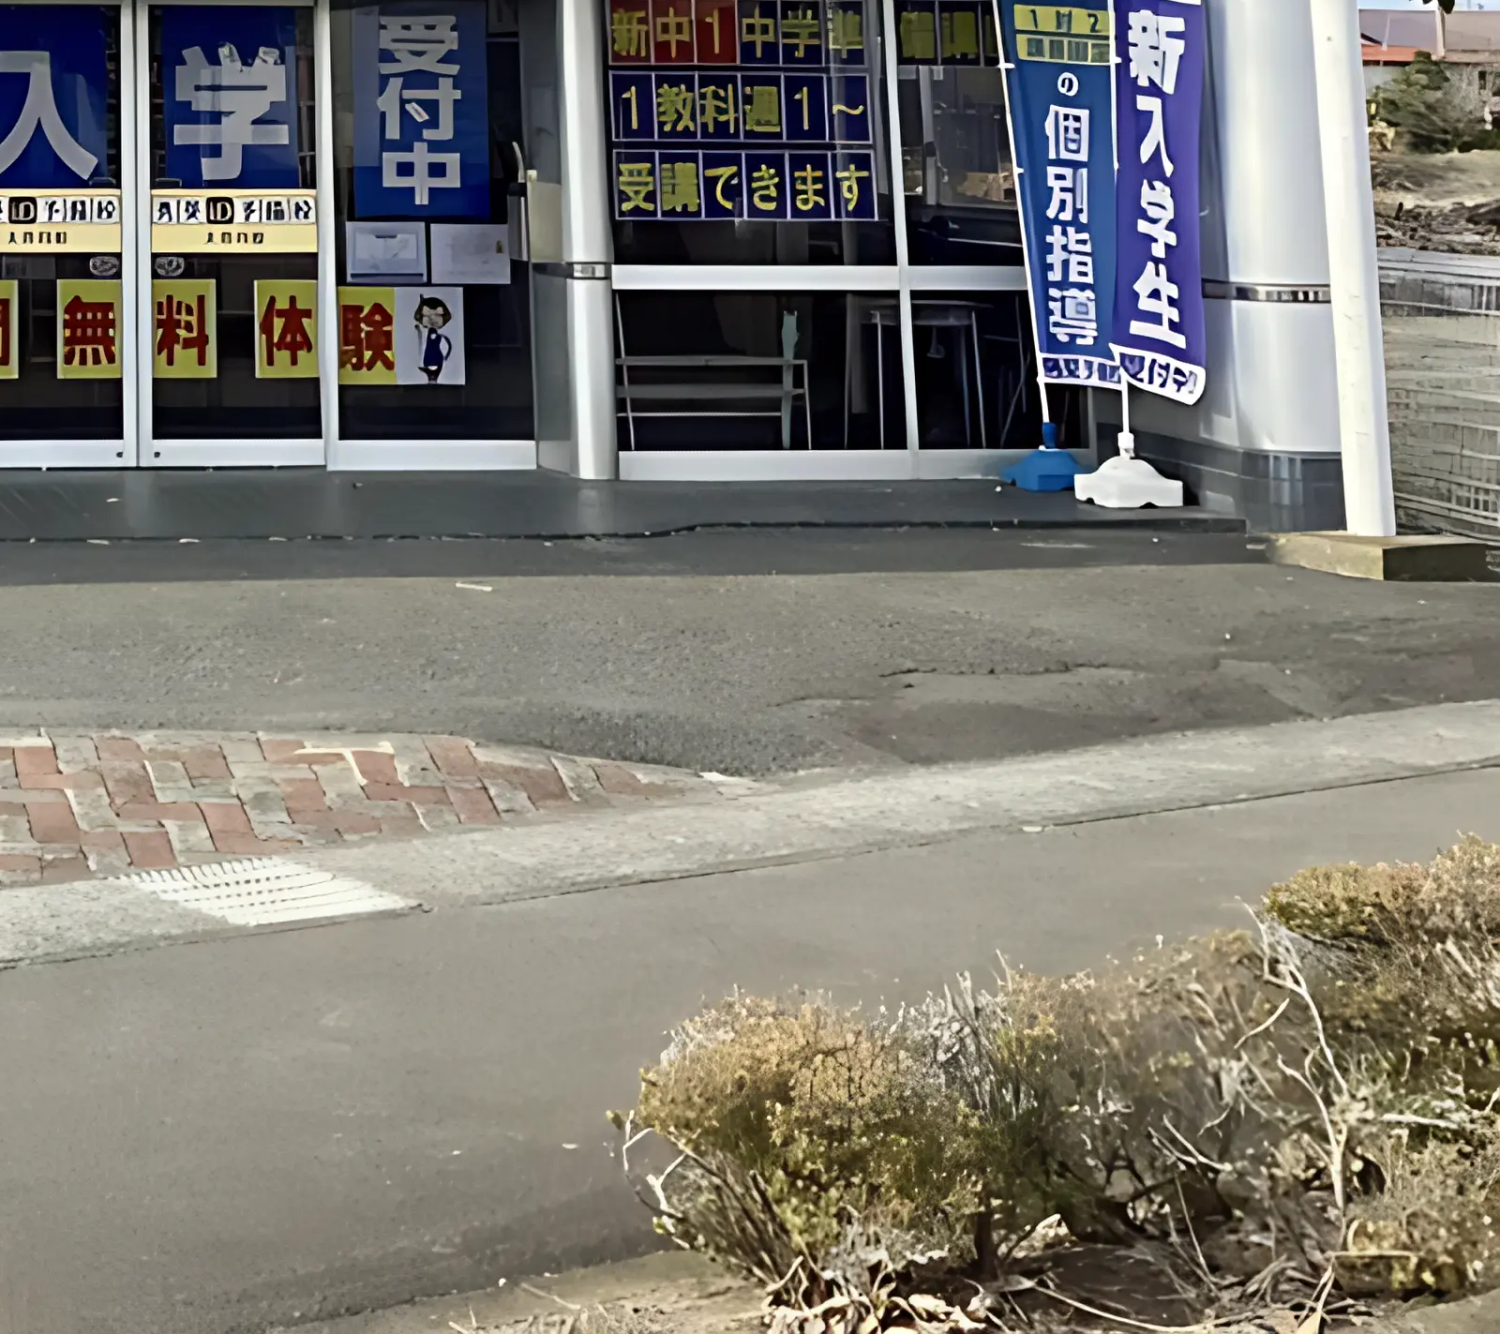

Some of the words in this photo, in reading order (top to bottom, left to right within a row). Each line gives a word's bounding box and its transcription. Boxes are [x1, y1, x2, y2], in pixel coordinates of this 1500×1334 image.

[376, 15, 462, 206] 受付中
[1127, 8, 1187, 350] 新入学生
